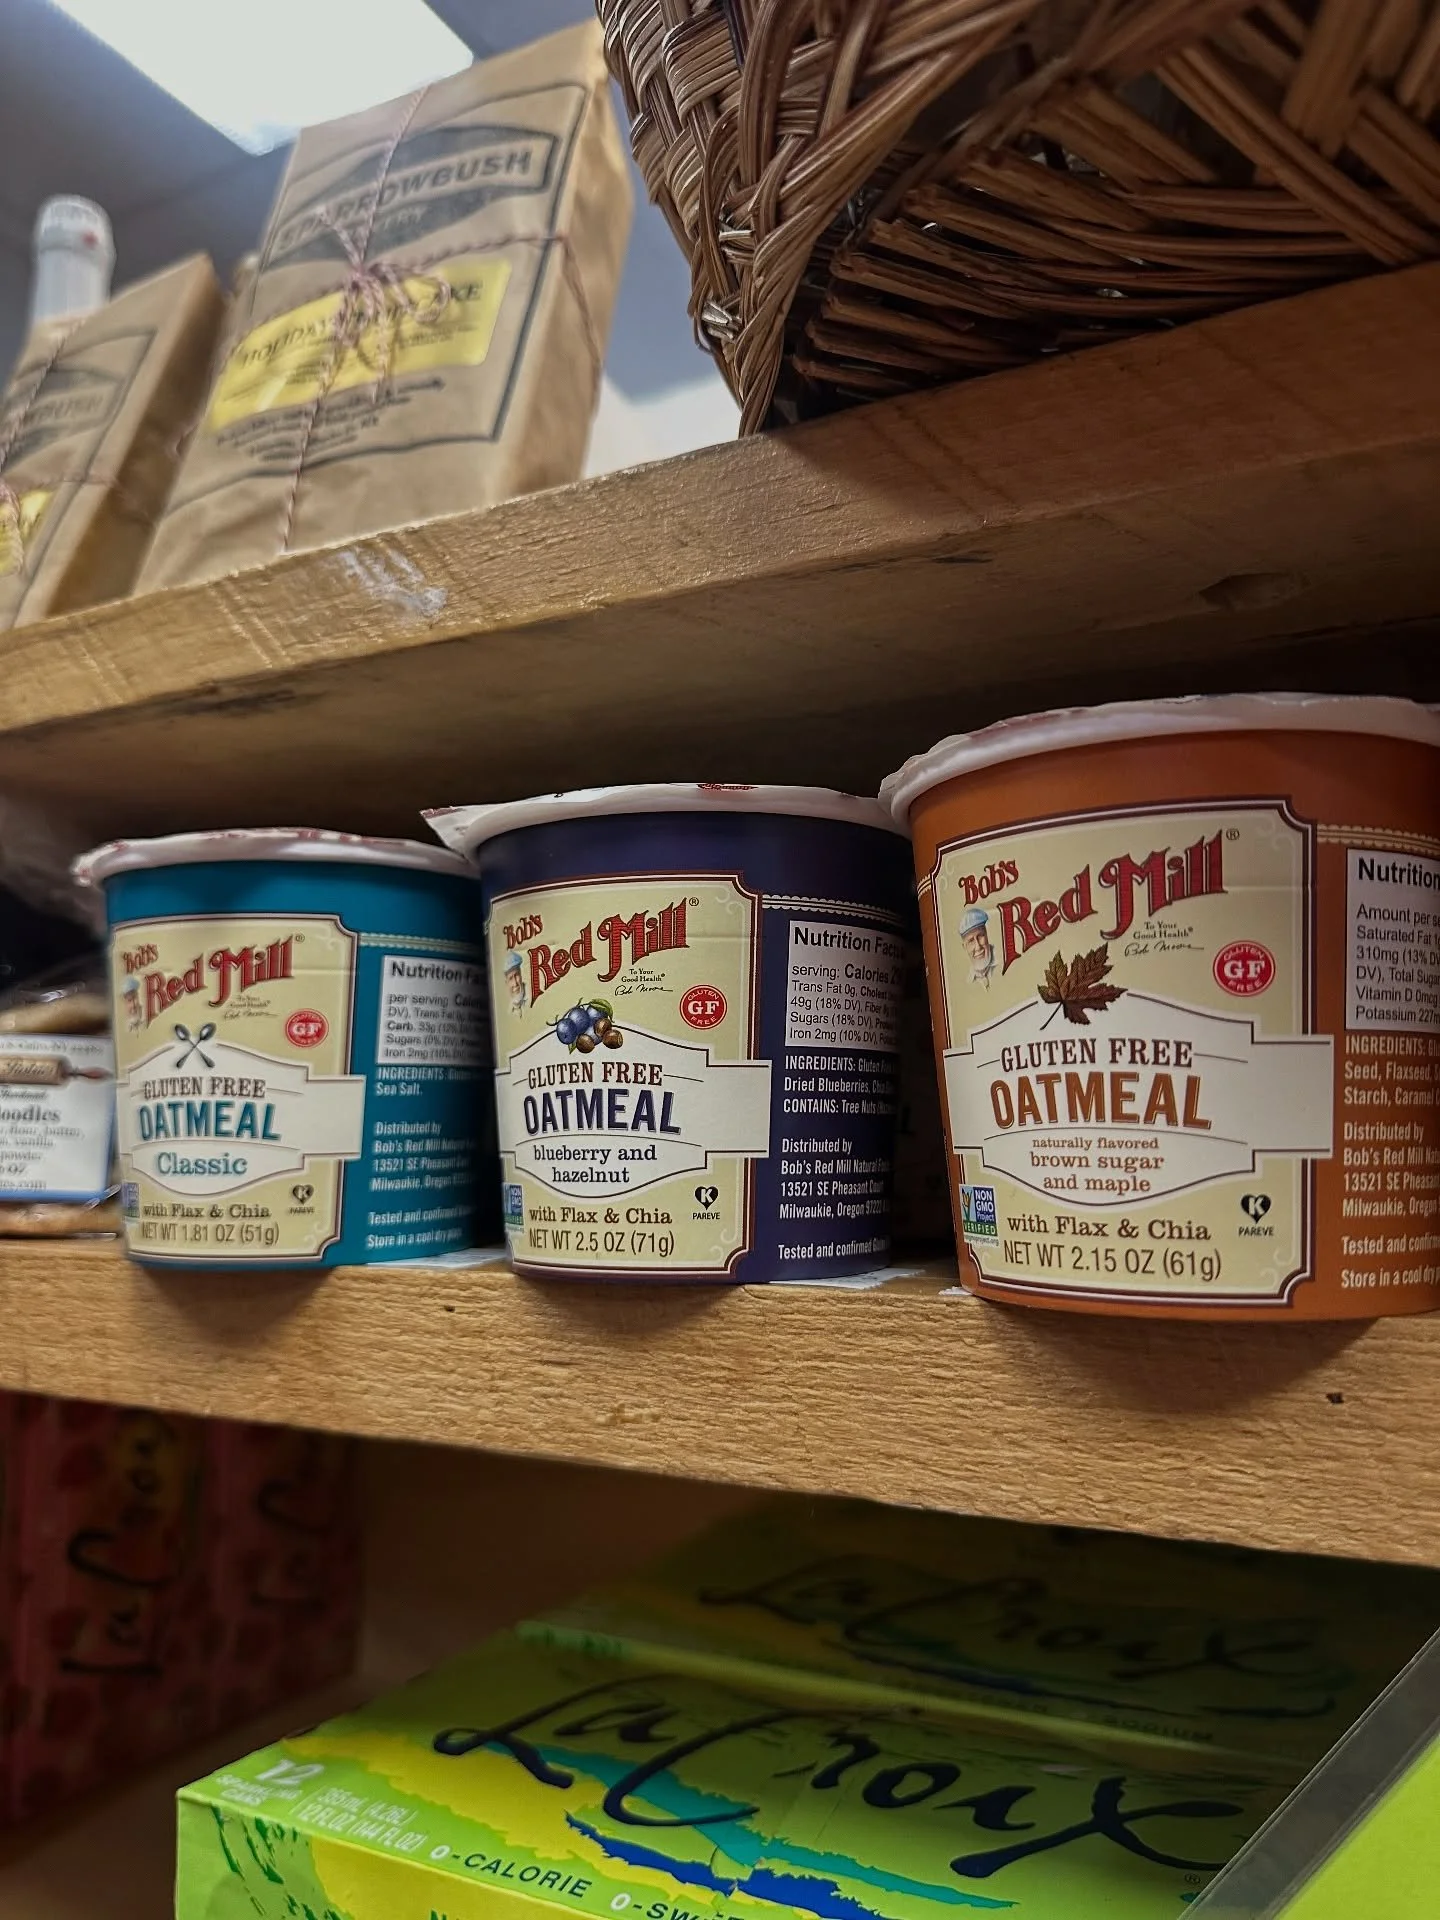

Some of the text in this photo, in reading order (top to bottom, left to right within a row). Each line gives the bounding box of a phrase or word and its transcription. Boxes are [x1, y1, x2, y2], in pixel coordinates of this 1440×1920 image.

[958, 859, 1020, 906] Bob's
[1358, 857, 1440, 891] Nutrition
[996, 864, 1099, 976] Red
[1356, 903, 1411, 923] Amount
[1413, 912, 1431, 927] per
[503, 914, 544, 950] Bob's
[1133, 929, 1156, 939] Good
[1157, 921, 1177, 930] Your
[794, 927, 871, 952] Nutrition
[1356, 925, 1432, 946] Saturated Fat
[123, 944, 159, 974] Bob's
[1224, 945, 1265, 961] GLUTEN
[1356, 946, 1428, 967] 310mg (13%
[391, 961, 462, 981] Nutrition
[527, 921, 597, 1008] Red
[791, 964, 840, 980] serving:
[844, 963, 889, 984] Calories
[1223, 960, 1266, 979] GF
[1356, 965, 1414, 984] DV), Total
[145, 954, 208, 1028] Red
[792, 980, 843, 994] Trans Fat
[1228, 979, 1263, 992] FREE
[1356, 986, 1413, 1002] Vitamin D
[688, 990, 719, 1001] GLUTEN
[790, 997, 841, 1012] 49g (18%
[687, 1001, 720, 1015] GF
[1356, 1005, 1417, 1023] Potassium
[690, 1016, 717, 1025] FREE
[790, 1012, 855, 1027] Sugars (18%
[790, 1028, 861, 1043] Iron 2mg (10%
[1345, 1035, 1427, 1056] INGREDIENTS:
[785, 1056, 856, 1071] INGREDIENTS:
[1001, 1038, 1193, 1073] GLUTEN FREE
[527, 1061, 663, 1089] GLUTEN FREE
[1344, 1061, 1382, 1081] Seed,
[1386, 1062, 1433, 1081] Flaxseed,
[143, 1076, 267, 1100] GLUTEN FREE
[376, 1083, 397, 1096] Sea
[784, 1077, 870, 1093] Dried Blueberries,
[783, 1099, 859, 1114] CONTAINS: Tree
[990, 1071, 1212, 1130] OATMEAL
[1344, 1086, 1434, 1108] Starch, Caramel
[139, 1100, 281, 1141] OATMEAL
[523, 1088, 682, 1136] OATMEAL
[375, 1121, 430, 1134] Distributed
[1344, 1121, 1424, 1143] Distributed by
[374, 1140, 403, 1153] Bob's
[406, 1139, 424, 1152] Red
[782, 1138, 852, 1155] Distributed by
[1032, 1136, 1160, 1151] naturally flavored
[157, 1152, 248, 1175] Classic
[533, 1145, 658, 1164] blueberry and
[1030, 1152, 1164, 1175] brown sugar
[1344, 1147, 1380, 1167] Bob's
[1383, 1147, 1405, 1165] Red
[1407, 1147, 1423, 1165] Mill
[373, 1157, 419, 1172] 13521 SE
[781, 1159, 851, 1175] Bob's Red Mill
[552, 1167, 630, 1183] hazelnut
[1043, 1174, 1151, 1195] and maple
[1344, 1171, 1400, 1192] 13521 SE
[781, 1180, 868, 1197] 13521 SE Pheasant
[975, 1190, 993, 1200] NON
[143, 1203, 272, 1218] with Flax & Chia
[529, 1206, 673, 1225] with Flax & Chia
[779, 1202, 864, 1219] Milwaukie, Oregon
[975, 1200, 994, 1212] GMO
[1342, 1195, 1437, 1218] Milwaukie, Oregon
[369, 1208, 421, 1225] Tested and
[692, 1212, 721, 1220] PAREVE
[141, 1222, 280, 1246] NET WT 1.81 OZ (51g)
[964, 1222, 996, 1235] VERIFIED
[1007, 1214, 1212, 1242] with Flax & Chia
[1238, 1226, 1274, 1237] PAREVE
[367, 1233, 395, 1248] Store
[529, 1229, 675, 1257] NET WT 2.5 OZ (71g)
[778, 1243, 813, 1259] Tested
[816, 1241, 834, 1257] and
[836, 1238, 872, 1256] confirmed
[1341, 1233, 1406, 1255] Tested and
[1003, 1240, 1032, 1265] NET
[1038, 1244, 1065, 1268] WT
[1071, 1247, 1117, 1273] 2.15
[1124, 1249, 1155, 1275] OZ
[1163, 1247, 1222, 1282] (61g)
[1341, 1264, 1423, 1289] Store in a cool
[255, 1759, 325, 1786] 12
